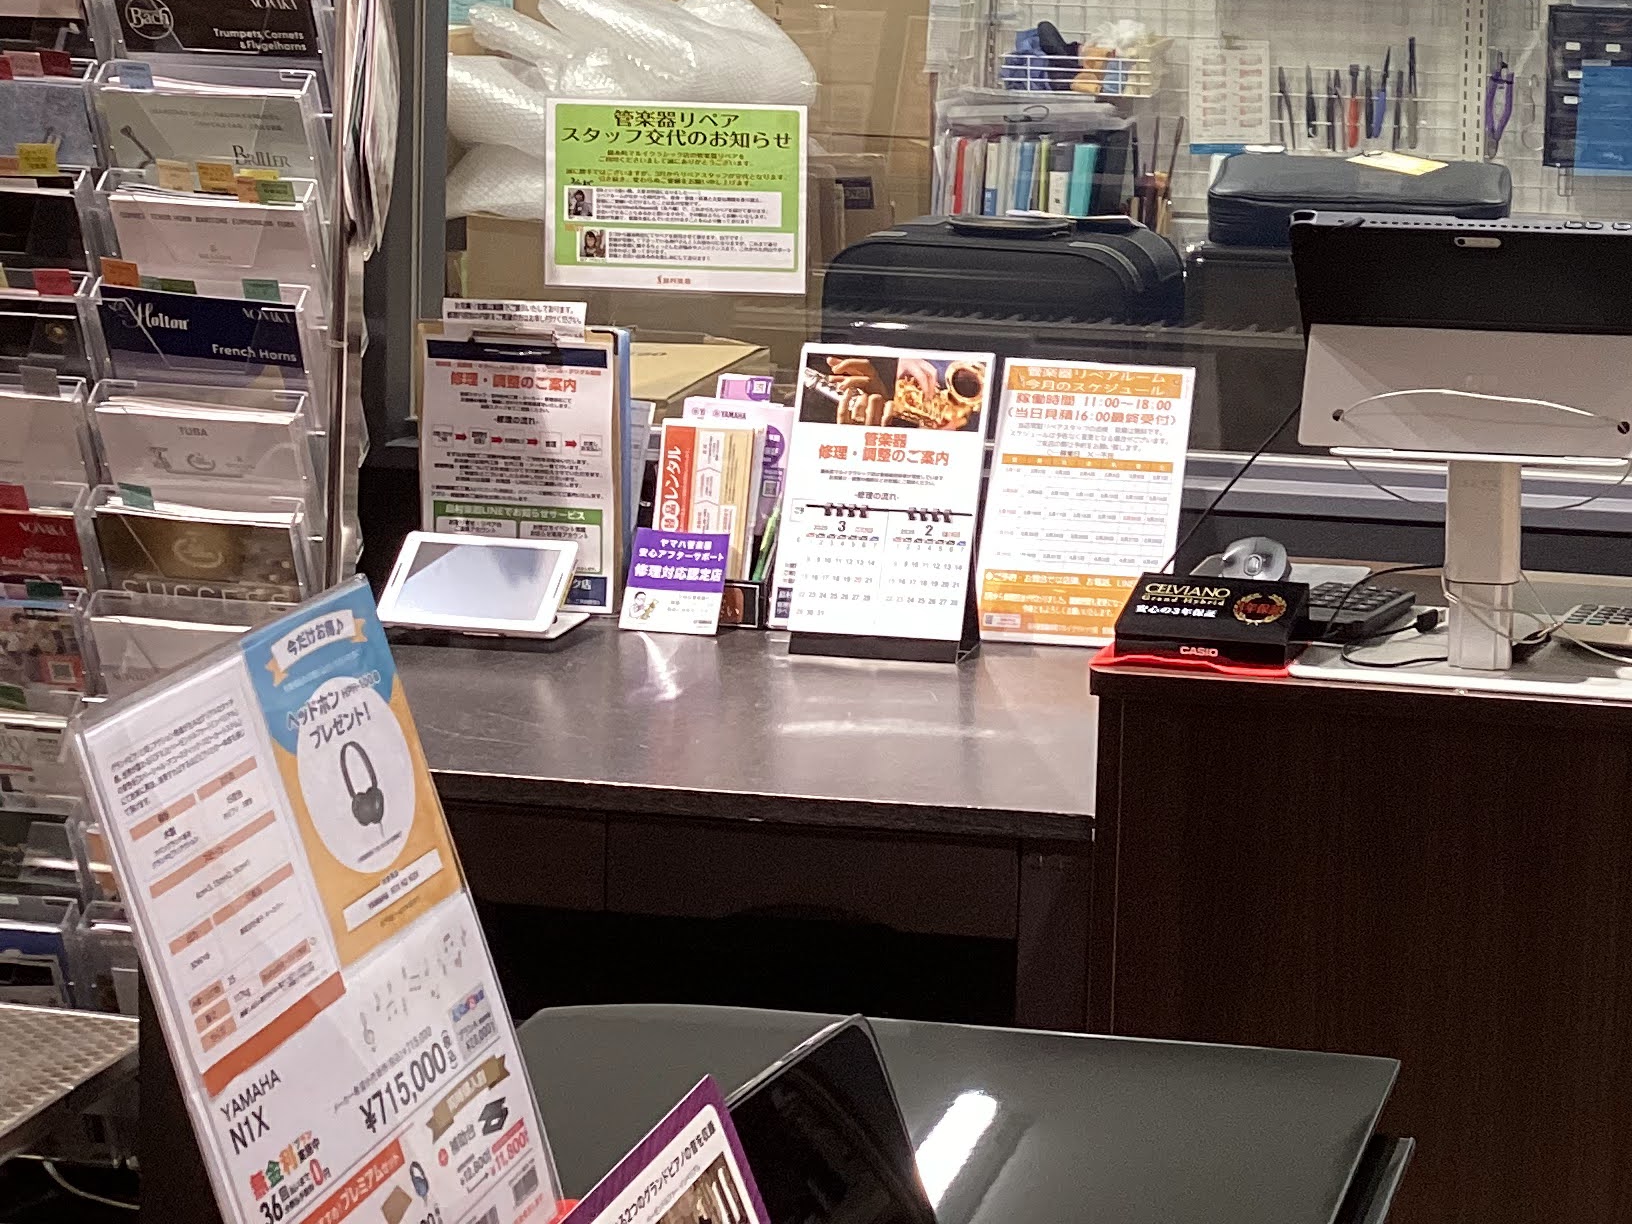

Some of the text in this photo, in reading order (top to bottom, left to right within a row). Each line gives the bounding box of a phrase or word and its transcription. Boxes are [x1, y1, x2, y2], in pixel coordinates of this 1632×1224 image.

[129, 7, 171, 28] Bach
[614, 109, 740, 129] 管楽器リペア
[561, 127, 793, 149] スタッフ交代のお知らせ
[212, 343, 297, 362] French Horns
[1025, 379, 1165, 396] 今月のスケジュール
[864, 432, 907, 448] 管楽器
[818, 444, 950, 466] 修理・調整のご案内
[838, 521, 846, 532] 3
[925, 525, 933, 536] 2
[638, 548, 725, 562] 安心アフターサポート
[634, 563, 723, 582] 修理対応認定店
[1145, 583, 1231, 598] CELVIANO
[1141, 594, 1226, 607] Grand Hybrid
[1135, 604, 1218, 618] 安心の3年保証
[1180, 646, 1219, 658] CASIO
[287, 691, 339, 731] ヘッドホン
[220, 1069, 282, 1122] YAMAHA
[359, 1042, 447, 1134] ¥715,000
[229, 1105, 271, 1156] N1X
[259, 1196, 284, 1224] 36
